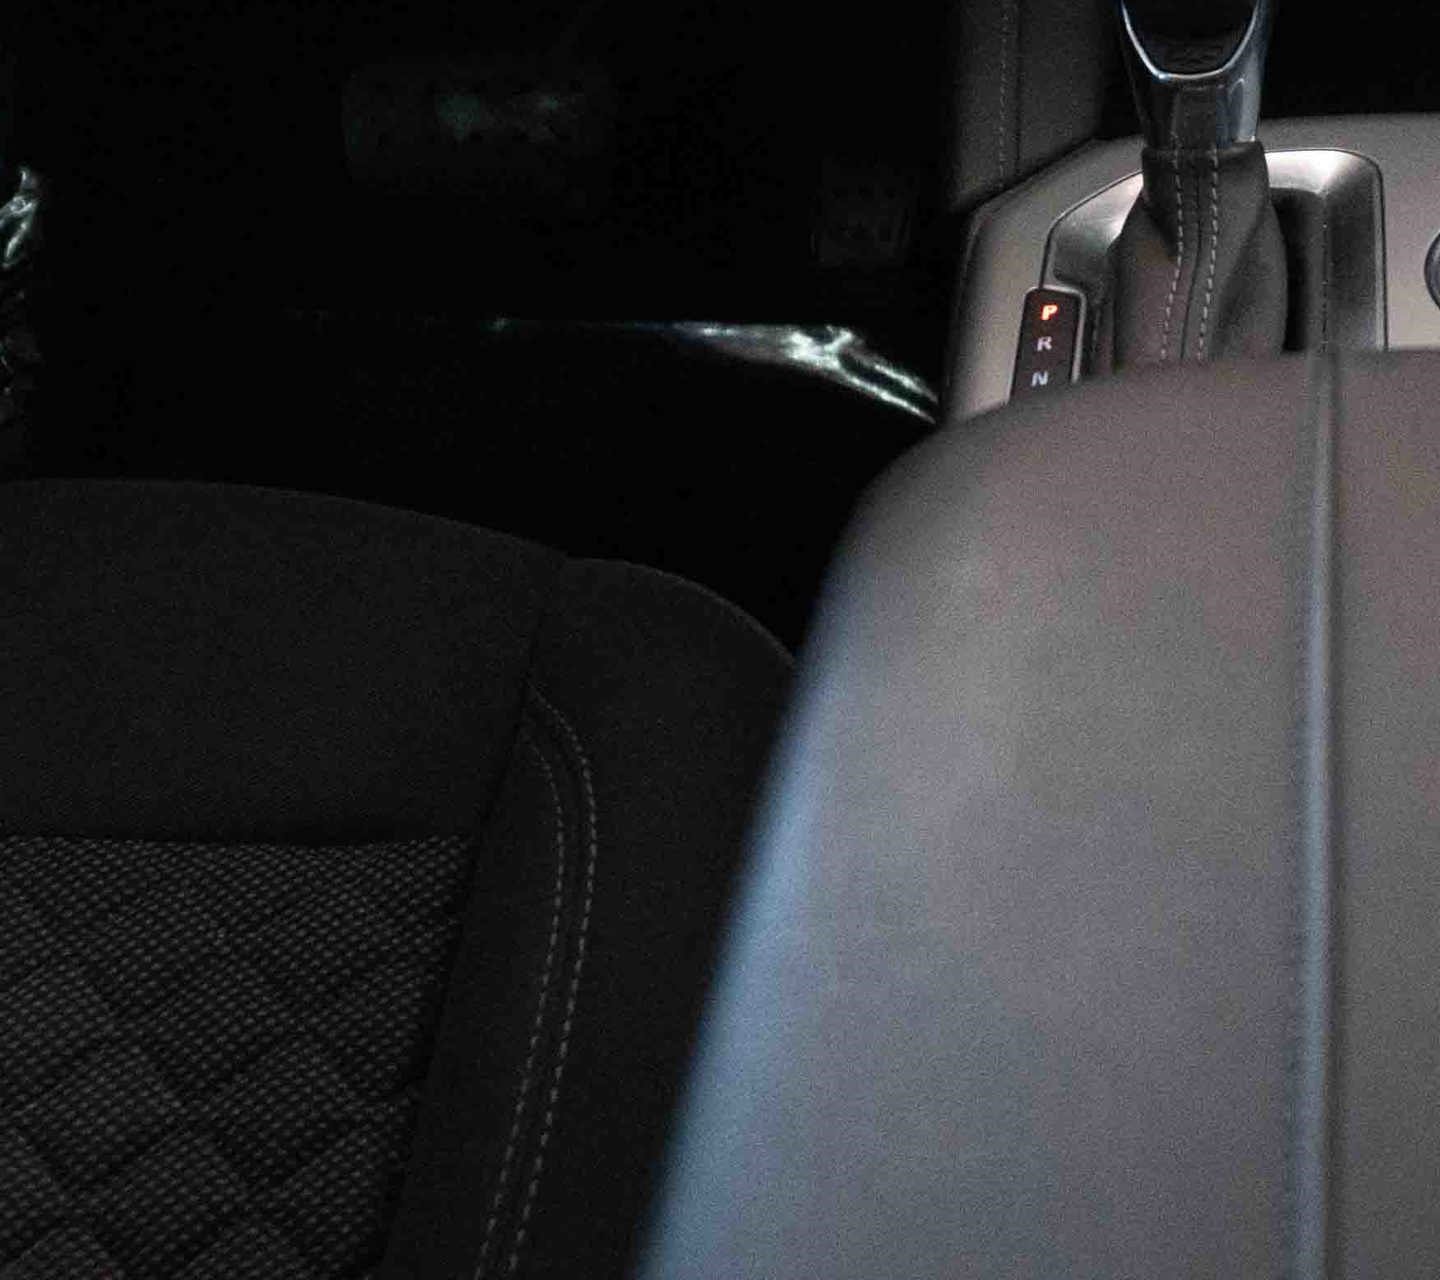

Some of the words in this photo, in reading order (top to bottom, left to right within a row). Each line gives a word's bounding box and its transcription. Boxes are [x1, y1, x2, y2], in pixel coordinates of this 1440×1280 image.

[1040, 303, 1058, 322] P
[1036, 335, 1053, 353] R
[1031, 371, 1049, 386] N
